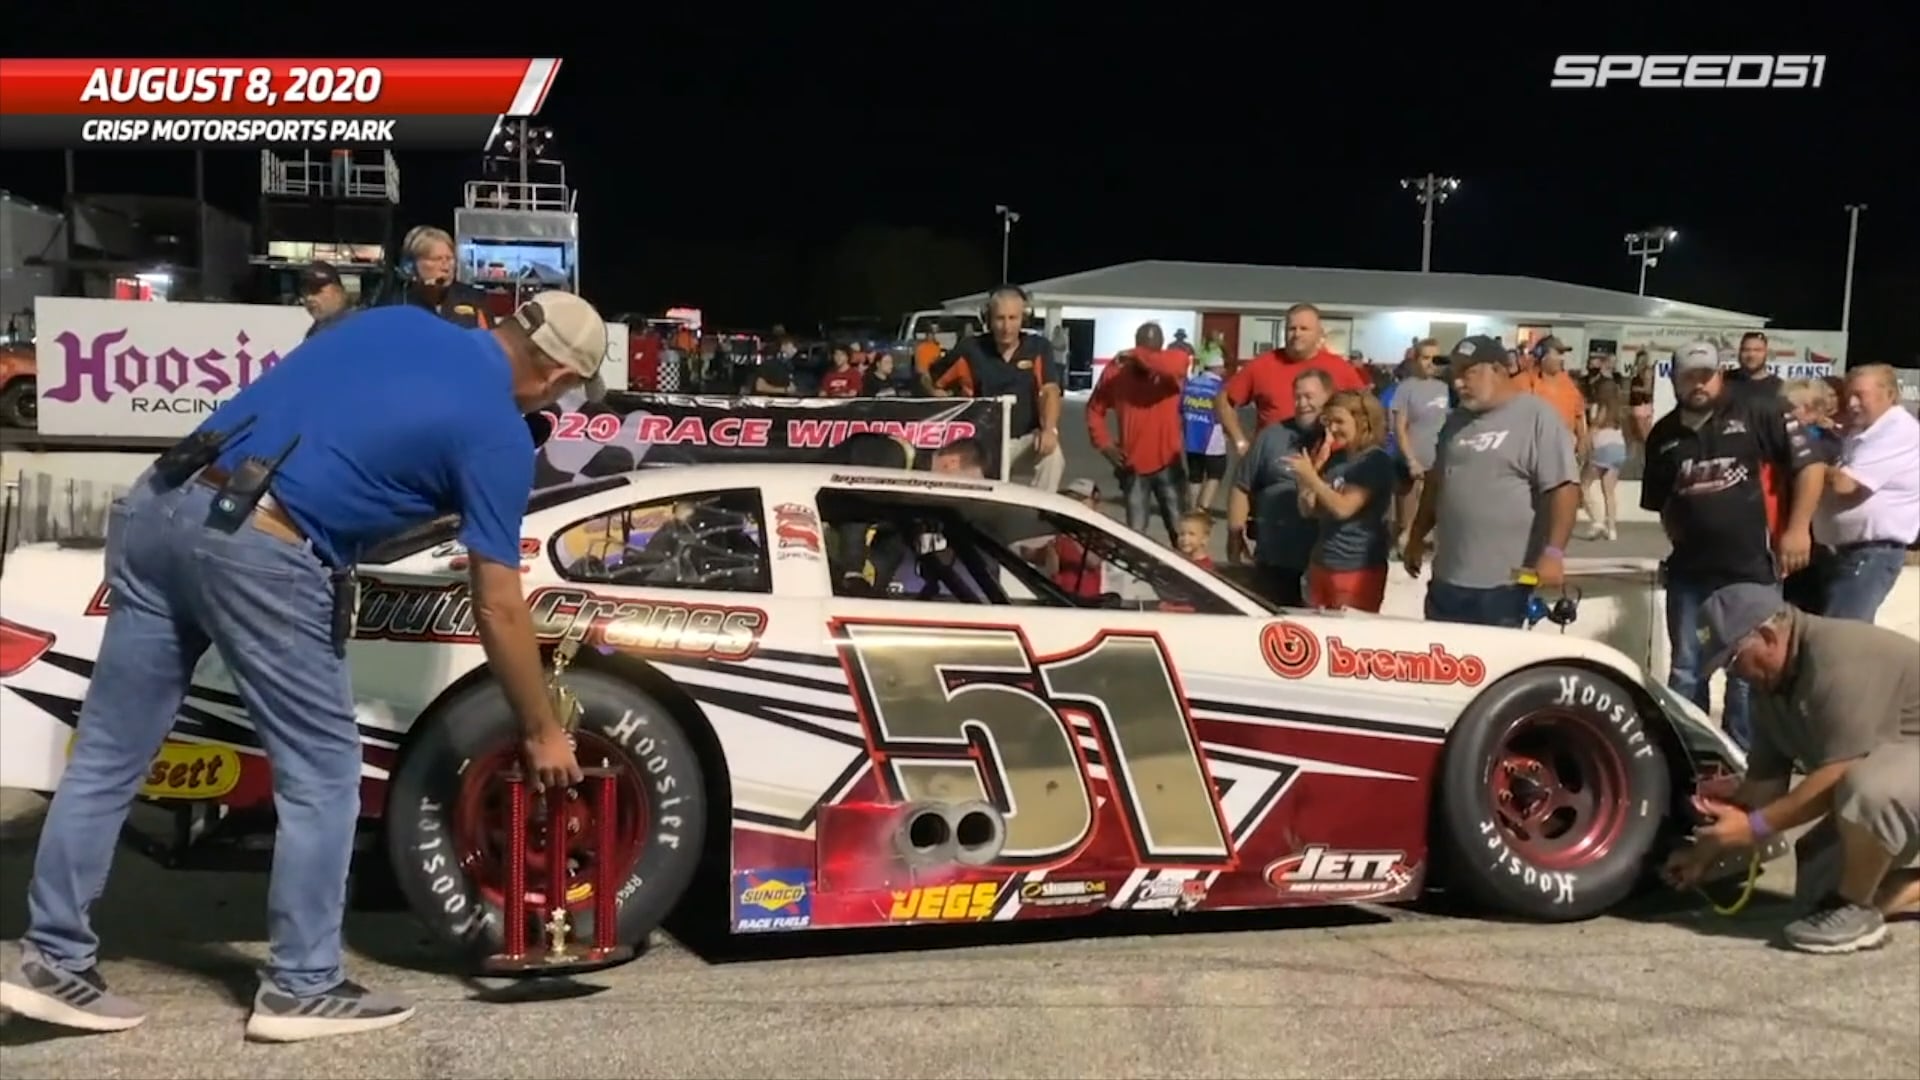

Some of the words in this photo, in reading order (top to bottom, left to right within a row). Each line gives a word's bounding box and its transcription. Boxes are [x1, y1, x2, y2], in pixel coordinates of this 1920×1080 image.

[635, 414, 773, 447] RACE
[529, 588, 762, 656] Cranes
[1327, 636, 1486, 686] brembo
[1552, 674, 1653, 758] Hoosier
[830, 617, 1238, 868] 51
[604, 708, 685, 850] Hoosier
[1280, 847, 1402, 880] JETT
[1479, 819, 1577, 904] Hoosier
[742, 885, 806, 903] SUNOCO
[889, 882, 998, 919] JEGS
[773, 916, 810, 926] FUELS
